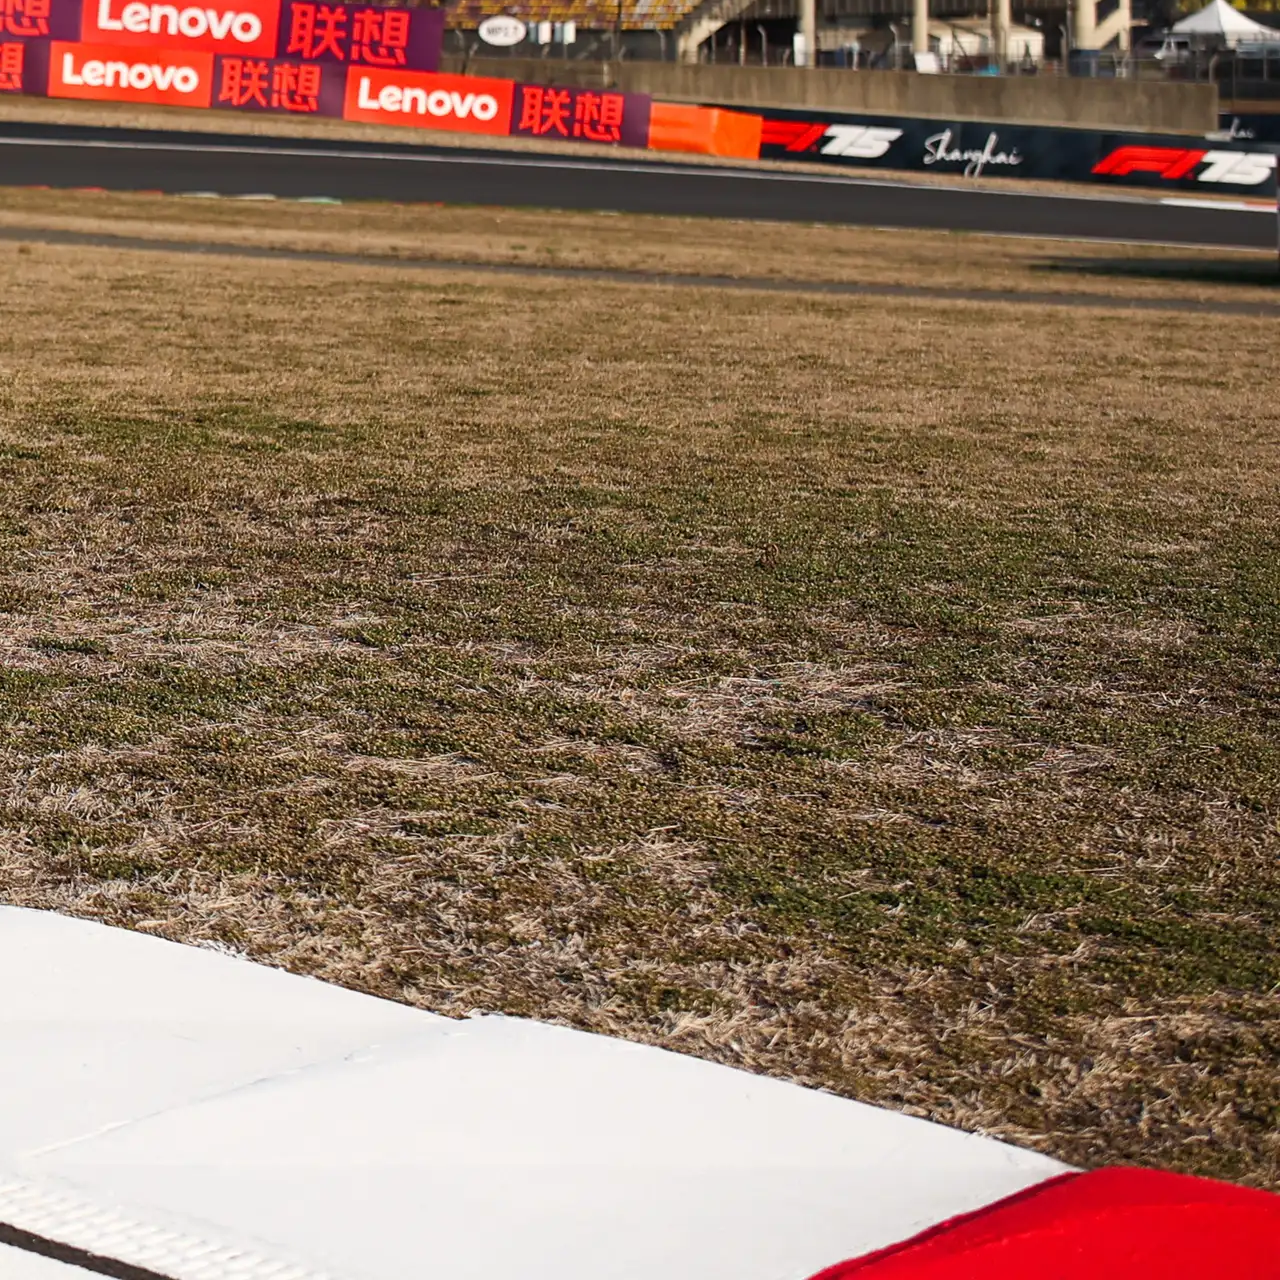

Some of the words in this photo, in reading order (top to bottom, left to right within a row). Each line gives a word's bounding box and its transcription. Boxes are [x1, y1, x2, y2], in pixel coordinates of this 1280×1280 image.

[287, 2, 409, 67] 联想
[62, 52, 199, 93] Lenovo
[218, 59, 321, 112] 联想
[357, 77, 498, 121] Lenovo
[519, 86, 623, 142] 联想
[923, 128, 1022, 178] Shanghai
